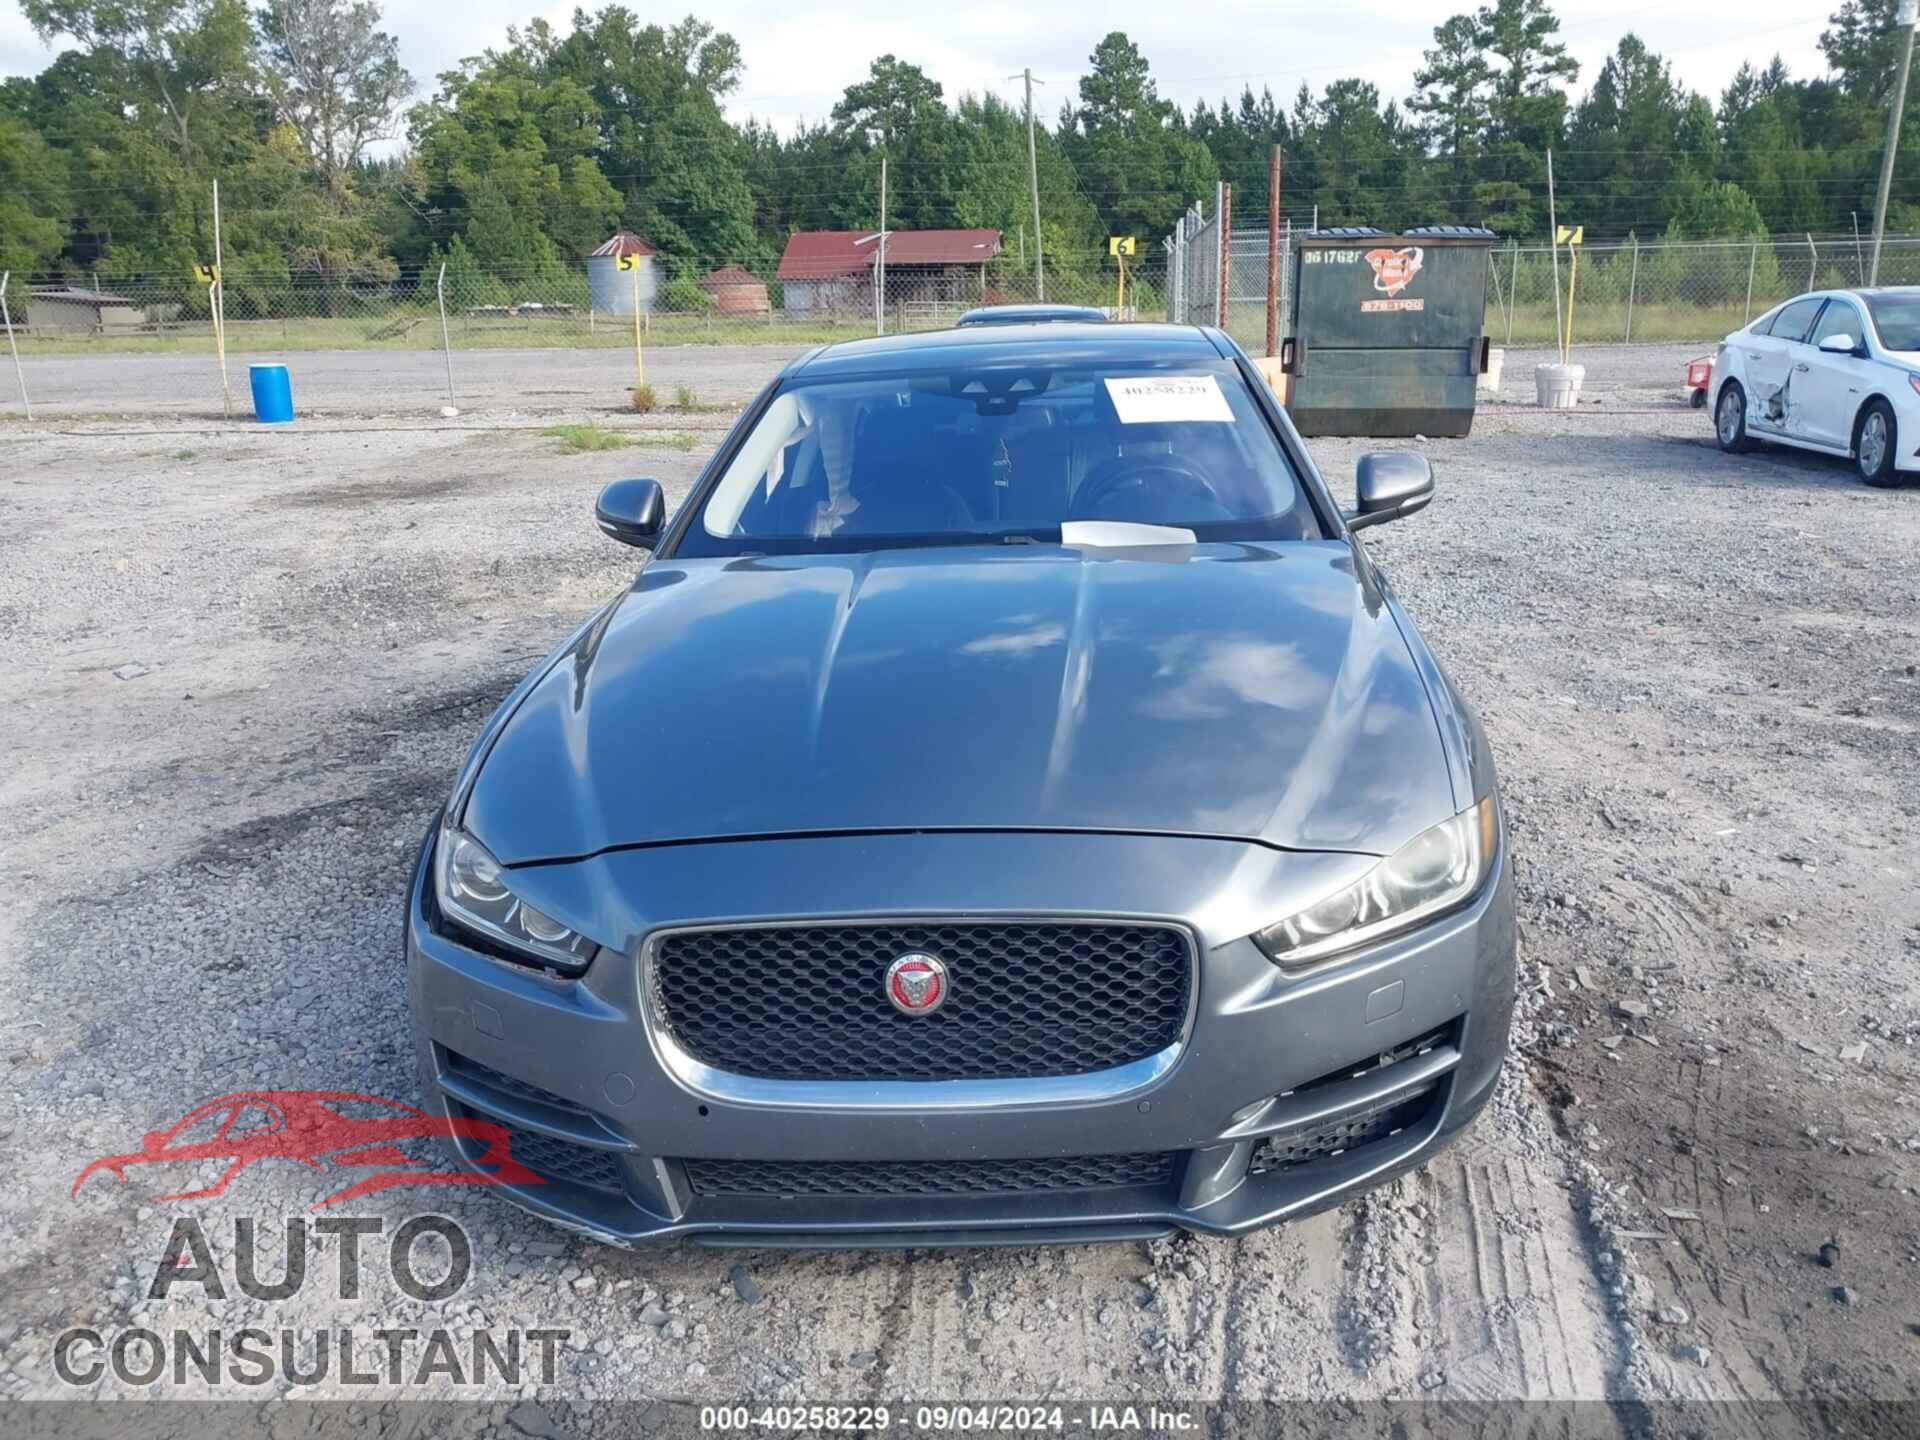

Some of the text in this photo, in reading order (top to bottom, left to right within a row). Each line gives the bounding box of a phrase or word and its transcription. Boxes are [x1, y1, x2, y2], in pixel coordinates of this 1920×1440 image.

[1563, 224, 1577, 245] 7
[1117, 236, 1128, 255] 6
[620, 253, 632, 270] 5
[200, 264, 215, 281] 4
